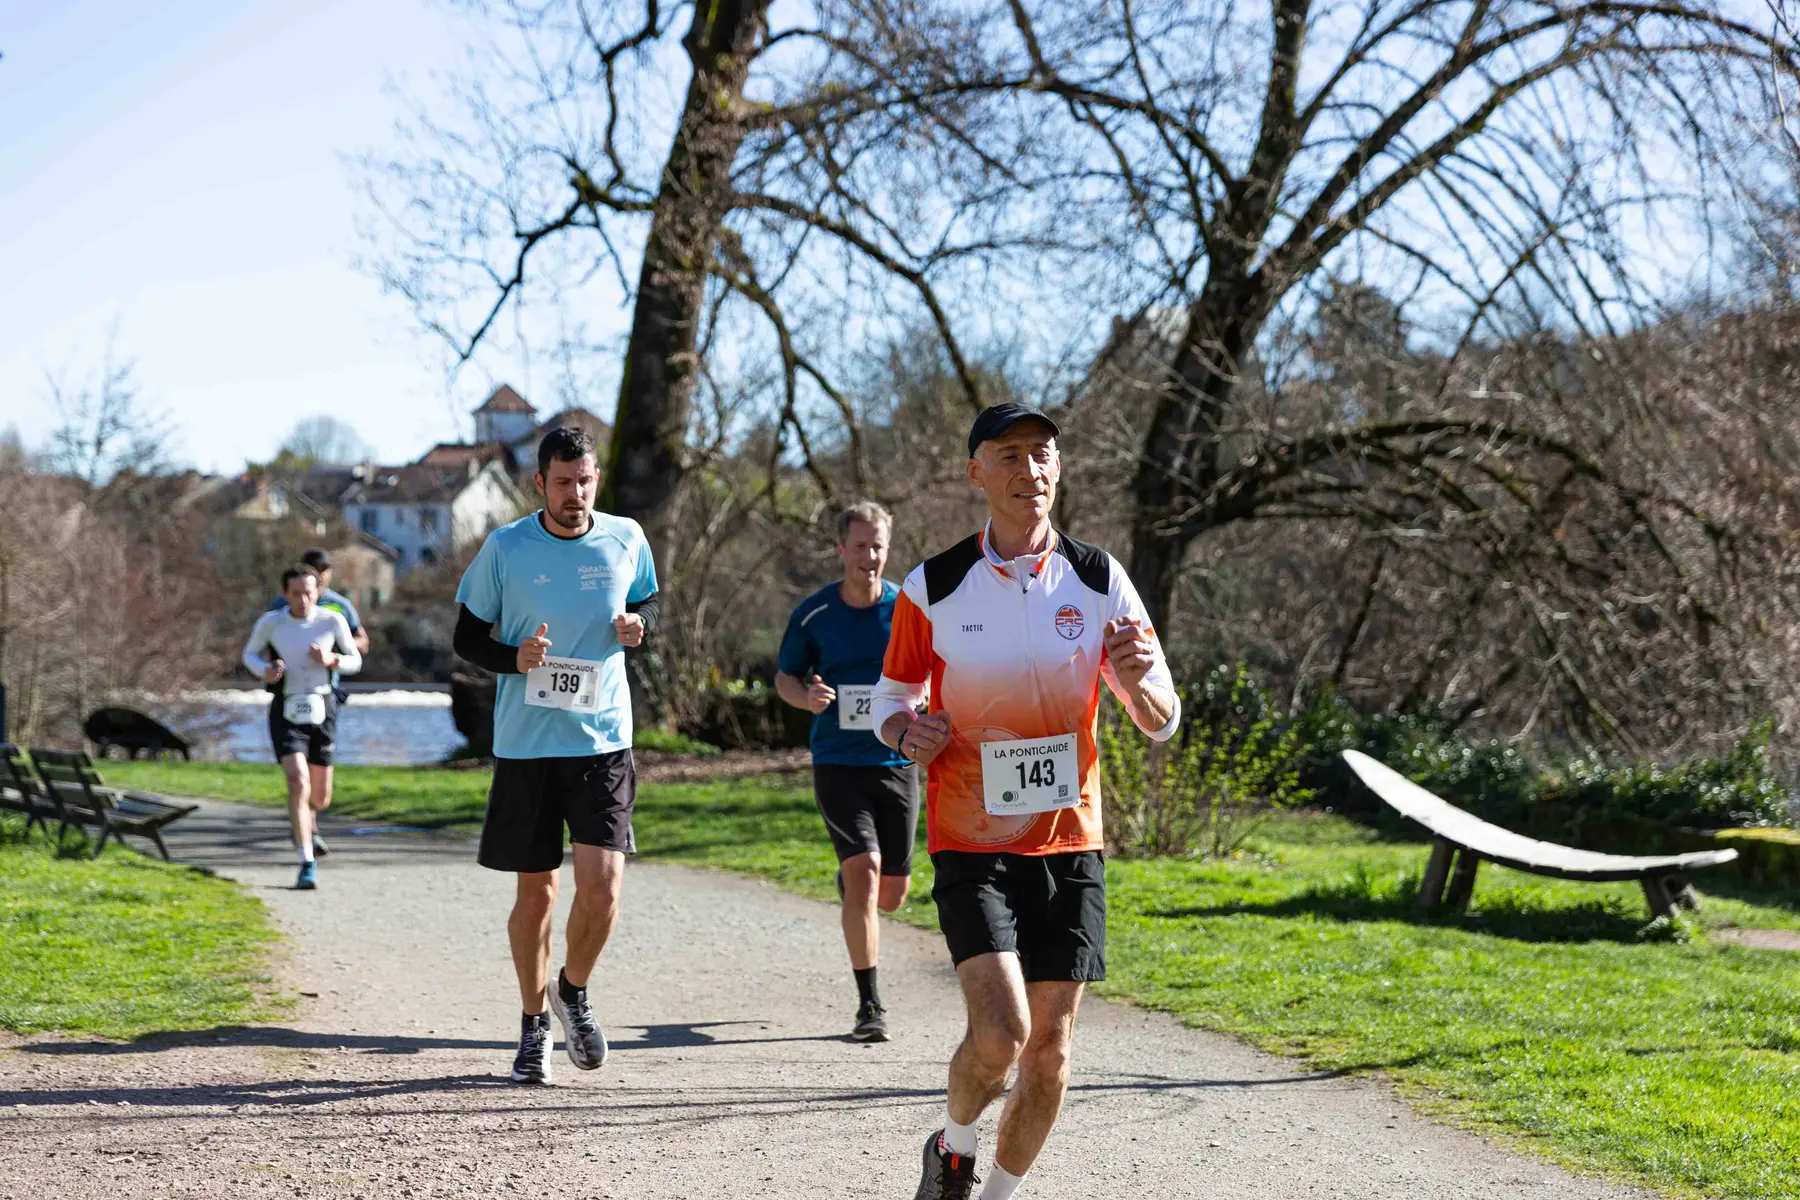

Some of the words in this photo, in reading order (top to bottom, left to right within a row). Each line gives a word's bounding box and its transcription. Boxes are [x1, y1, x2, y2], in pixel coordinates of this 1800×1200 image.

[962, 624, 983, 632] TACTIC
[1055, 617, 1084, 625] CRC
[548, 661, 594, 673] PONTICAUDE
[551, 672, 580, 694] 139
[856, 698, 871, 715] 22
[994, 750, 1007, 759] LA
[1010, 742, 1069, 758] PONTICAUDE
[1015, 758, 1055, 789] 143
